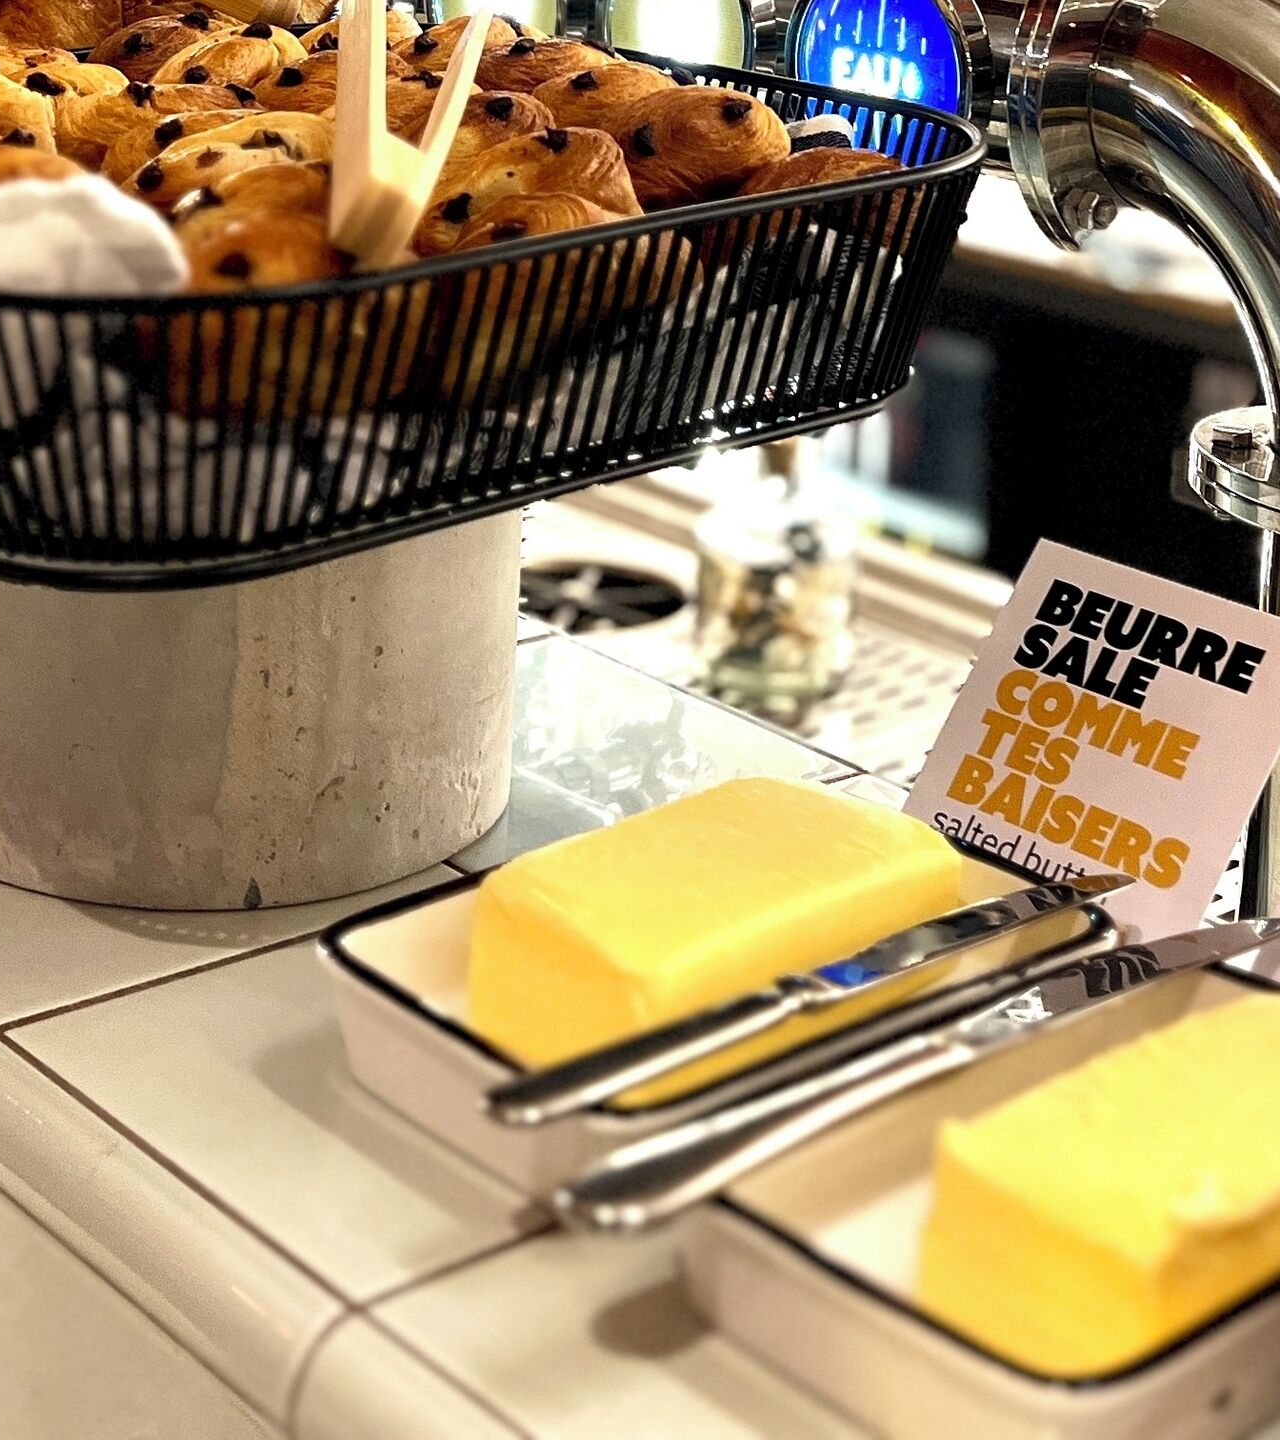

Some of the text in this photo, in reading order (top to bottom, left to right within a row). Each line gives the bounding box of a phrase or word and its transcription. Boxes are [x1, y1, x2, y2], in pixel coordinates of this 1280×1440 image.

[831, 46, 902, 97] EAU
[1013, 623, 1160, 709] SALE
[1035, 578, 1266, 695] BEURRE
[977, 708, 1079, 785] TES
[996, 668, 1201, 780] COMME
[932, 811, 1022, 861] salted
[946, 754, 1191, 890] BAISERS
